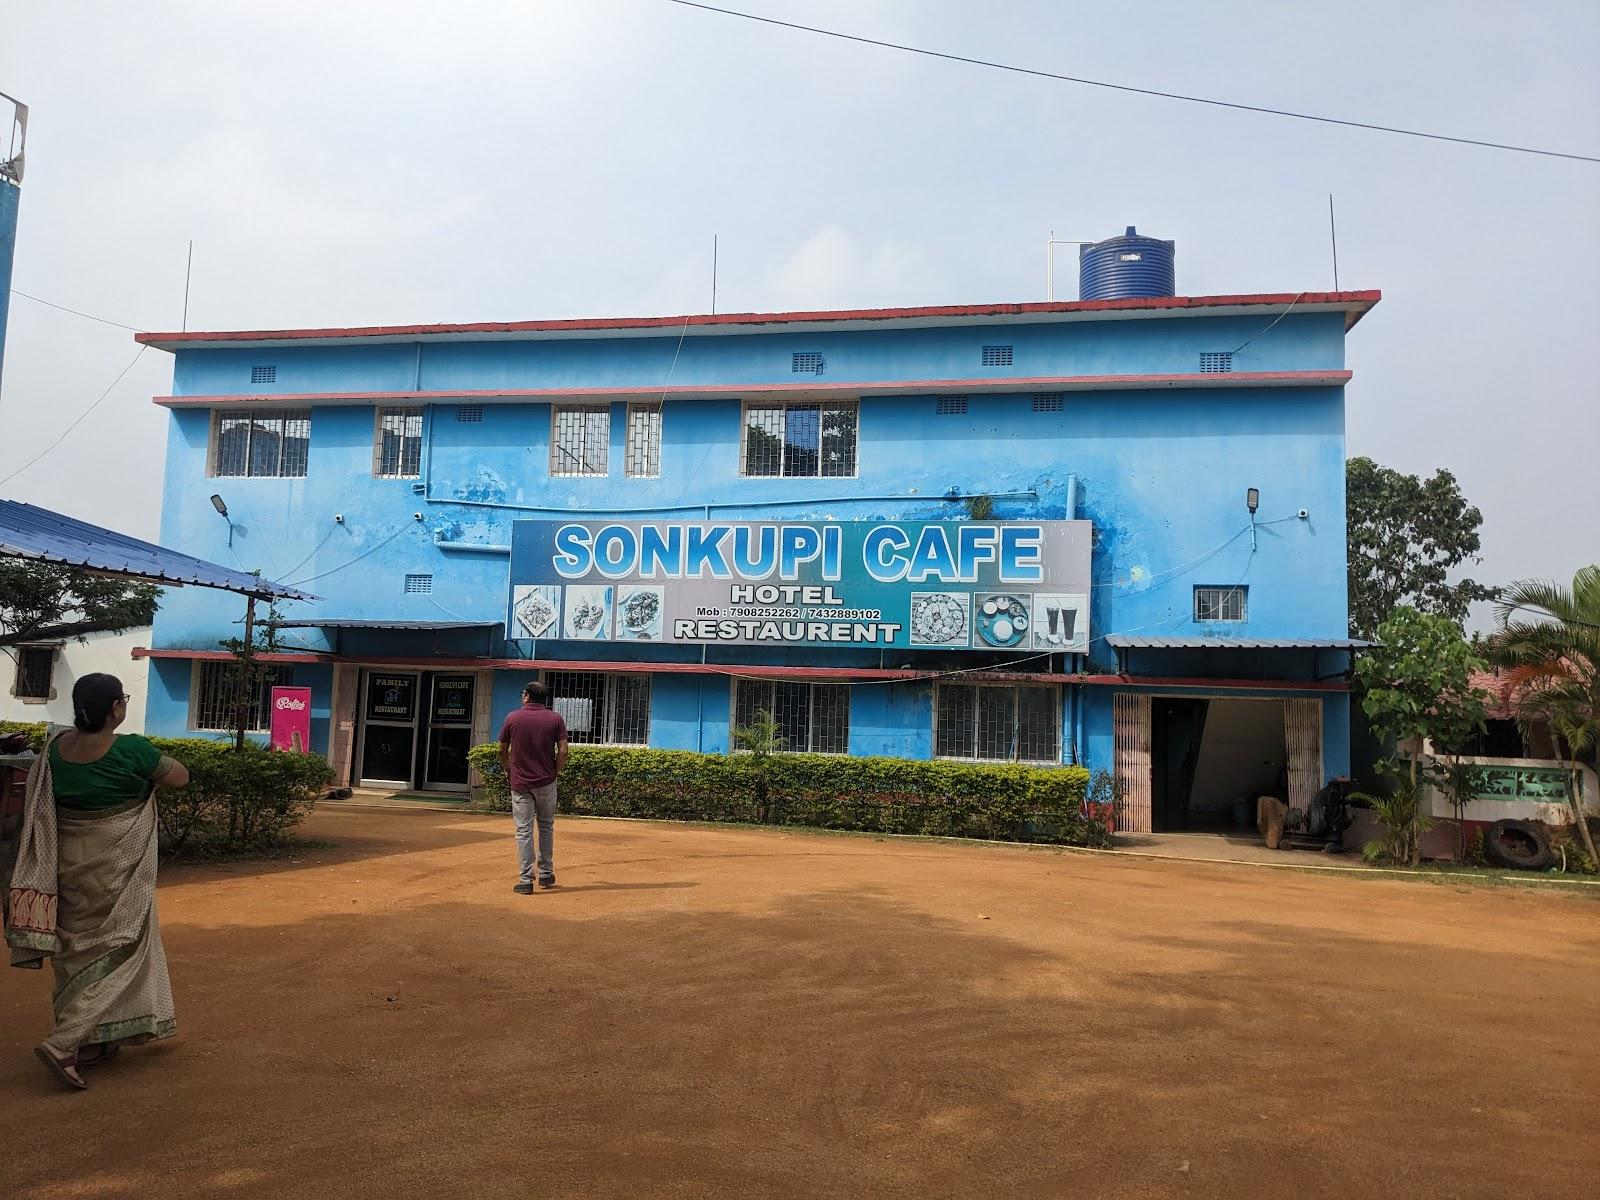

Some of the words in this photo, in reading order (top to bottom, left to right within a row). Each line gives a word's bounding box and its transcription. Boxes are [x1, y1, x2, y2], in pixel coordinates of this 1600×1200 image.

[552, 524, 842, 581] SONKUPI
[863, 524, 1044, 583] CAFE
[731, 585, 843, 605] HOTEL
[696, 607, 720, 617] Mob
[730, 607, 799, 618] 7908252262
[809, 609, 881, 619] 7432889102
[674, 619, 901, 643] RESTAURENT
[375, 679, 410, 687] FAMILY
